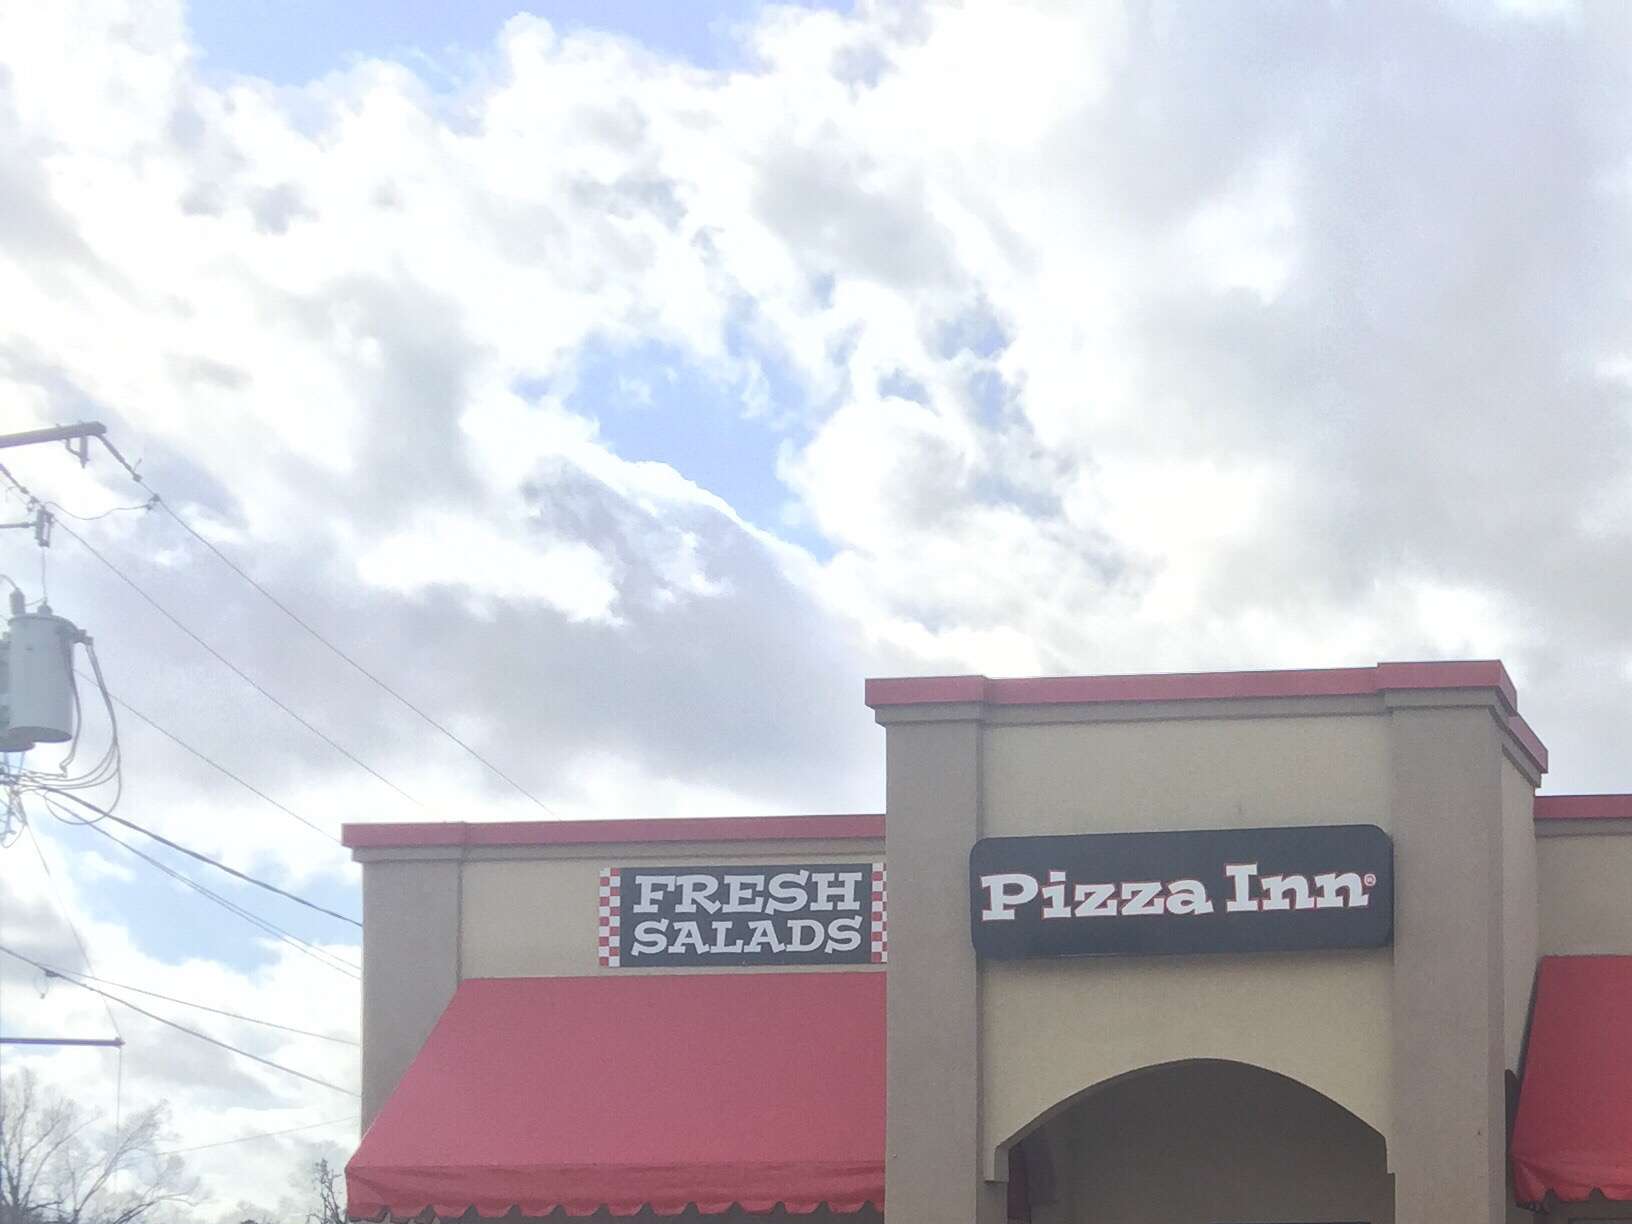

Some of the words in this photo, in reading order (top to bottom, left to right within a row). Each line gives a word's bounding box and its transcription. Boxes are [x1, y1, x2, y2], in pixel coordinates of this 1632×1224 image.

[632, 870, 863, 915] FRESH
[980, 868, 1214, 921] Pizza
[631, 915, 863, 957] SALADS
